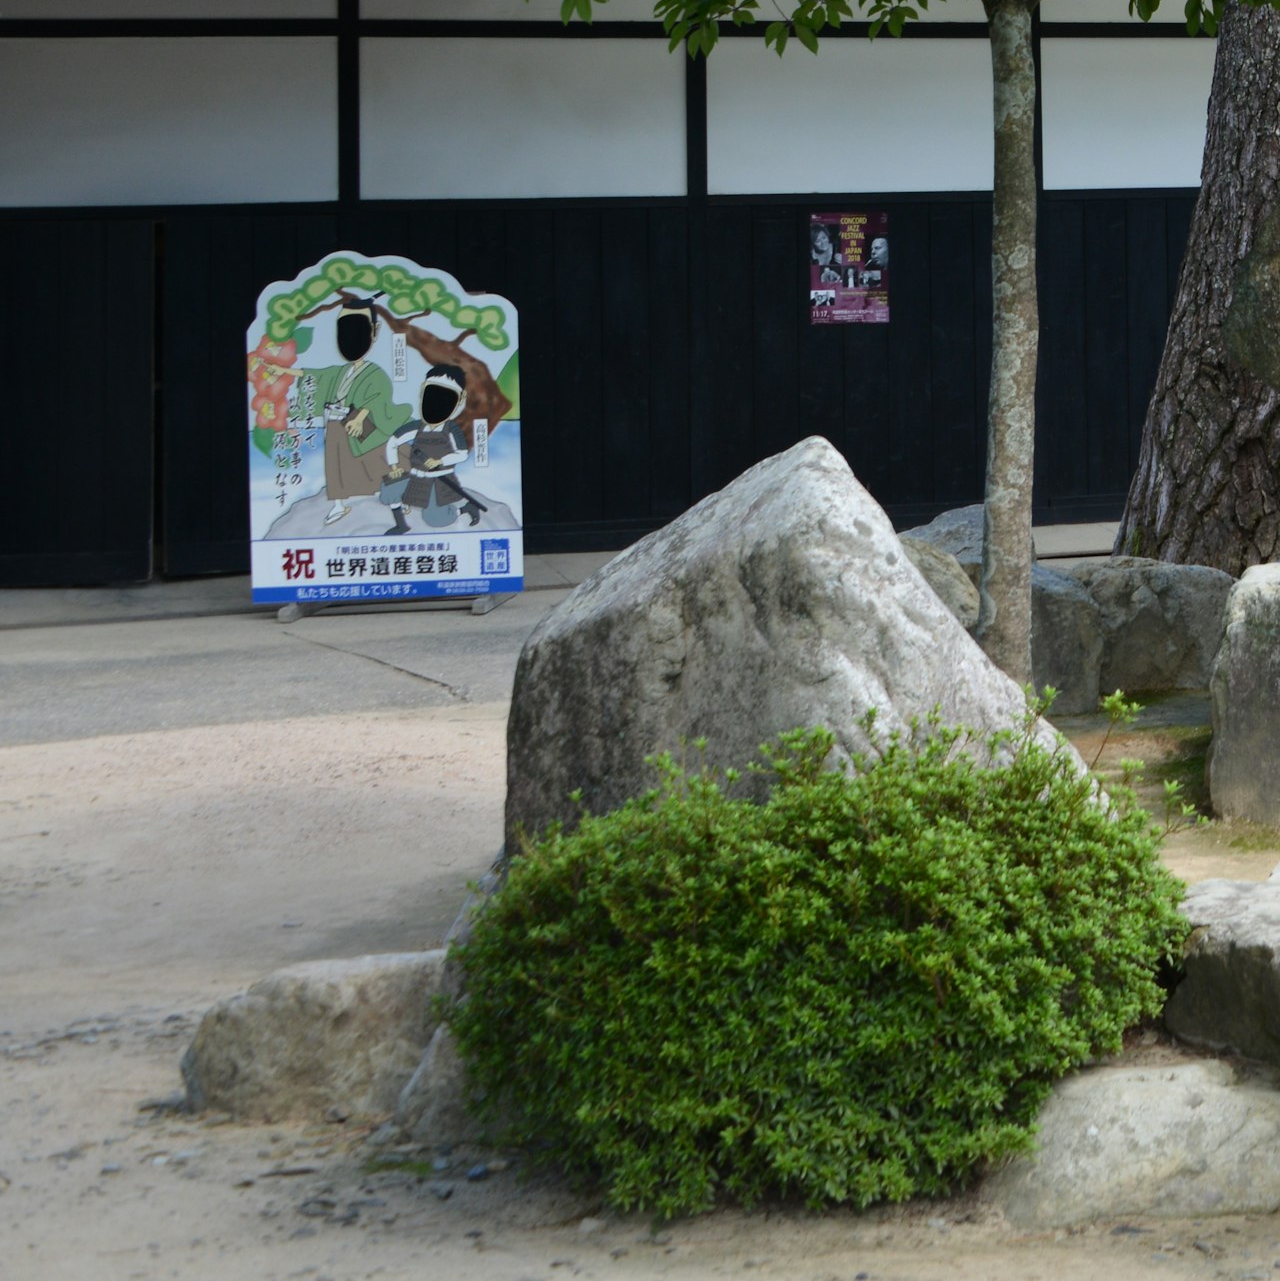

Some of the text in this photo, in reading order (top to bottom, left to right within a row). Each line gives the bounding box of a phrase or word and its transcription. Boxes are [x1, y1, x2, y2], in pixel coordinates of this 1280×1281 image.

[840, 217, 867, 225] CONCORD
[845, 247, 862, 255] JAPAN
[394, 338, 405, 377] 吉田松陰
[282, 548, 316, 580] 祝
[326, 554, 458, 578] 世界遺産登録
[297, 584, 417, 599] 私たちも応援しています。
